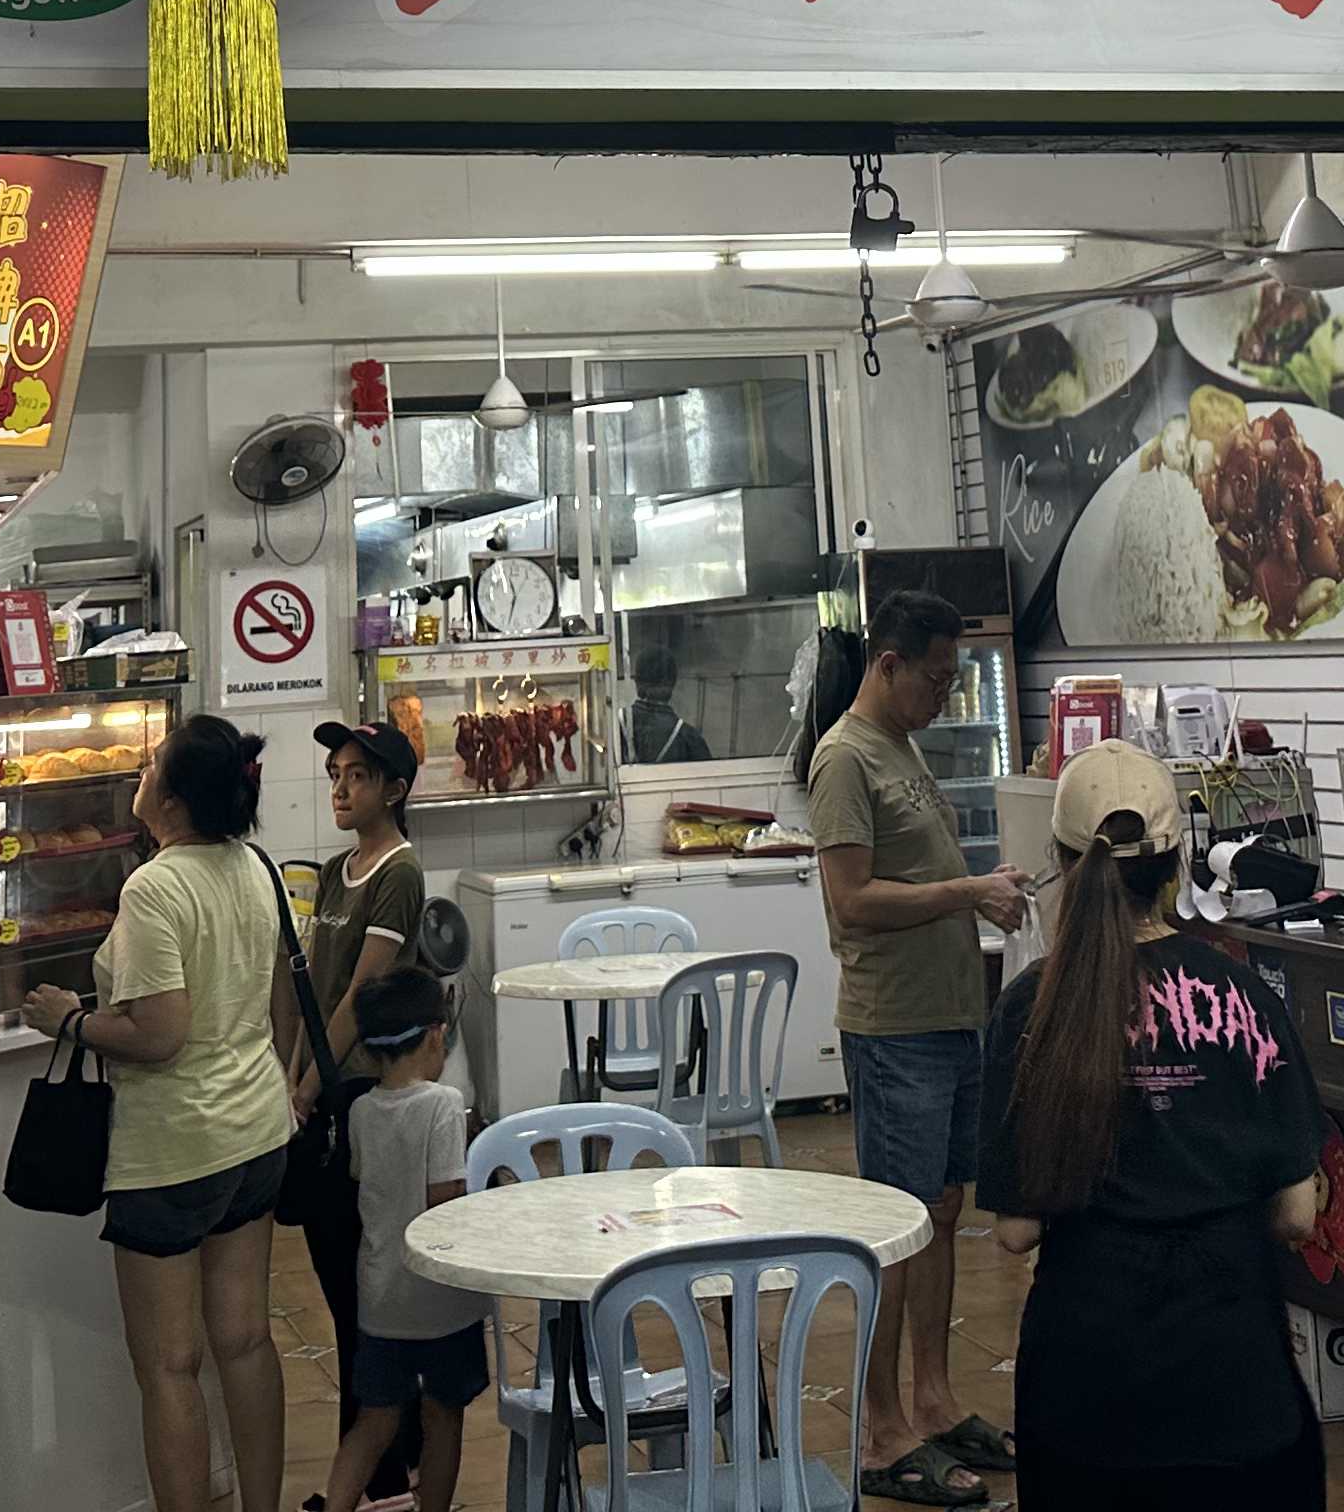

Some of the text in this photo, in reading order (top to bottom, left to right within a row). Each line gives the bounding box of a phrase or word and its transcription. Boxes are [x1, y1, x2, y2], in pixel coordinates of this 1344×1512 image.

[16, 317, 51, 350] A1
[997, 453, 1056, 565] Rice
[226, 677, 323, 695] DILARANG MEROKOK
